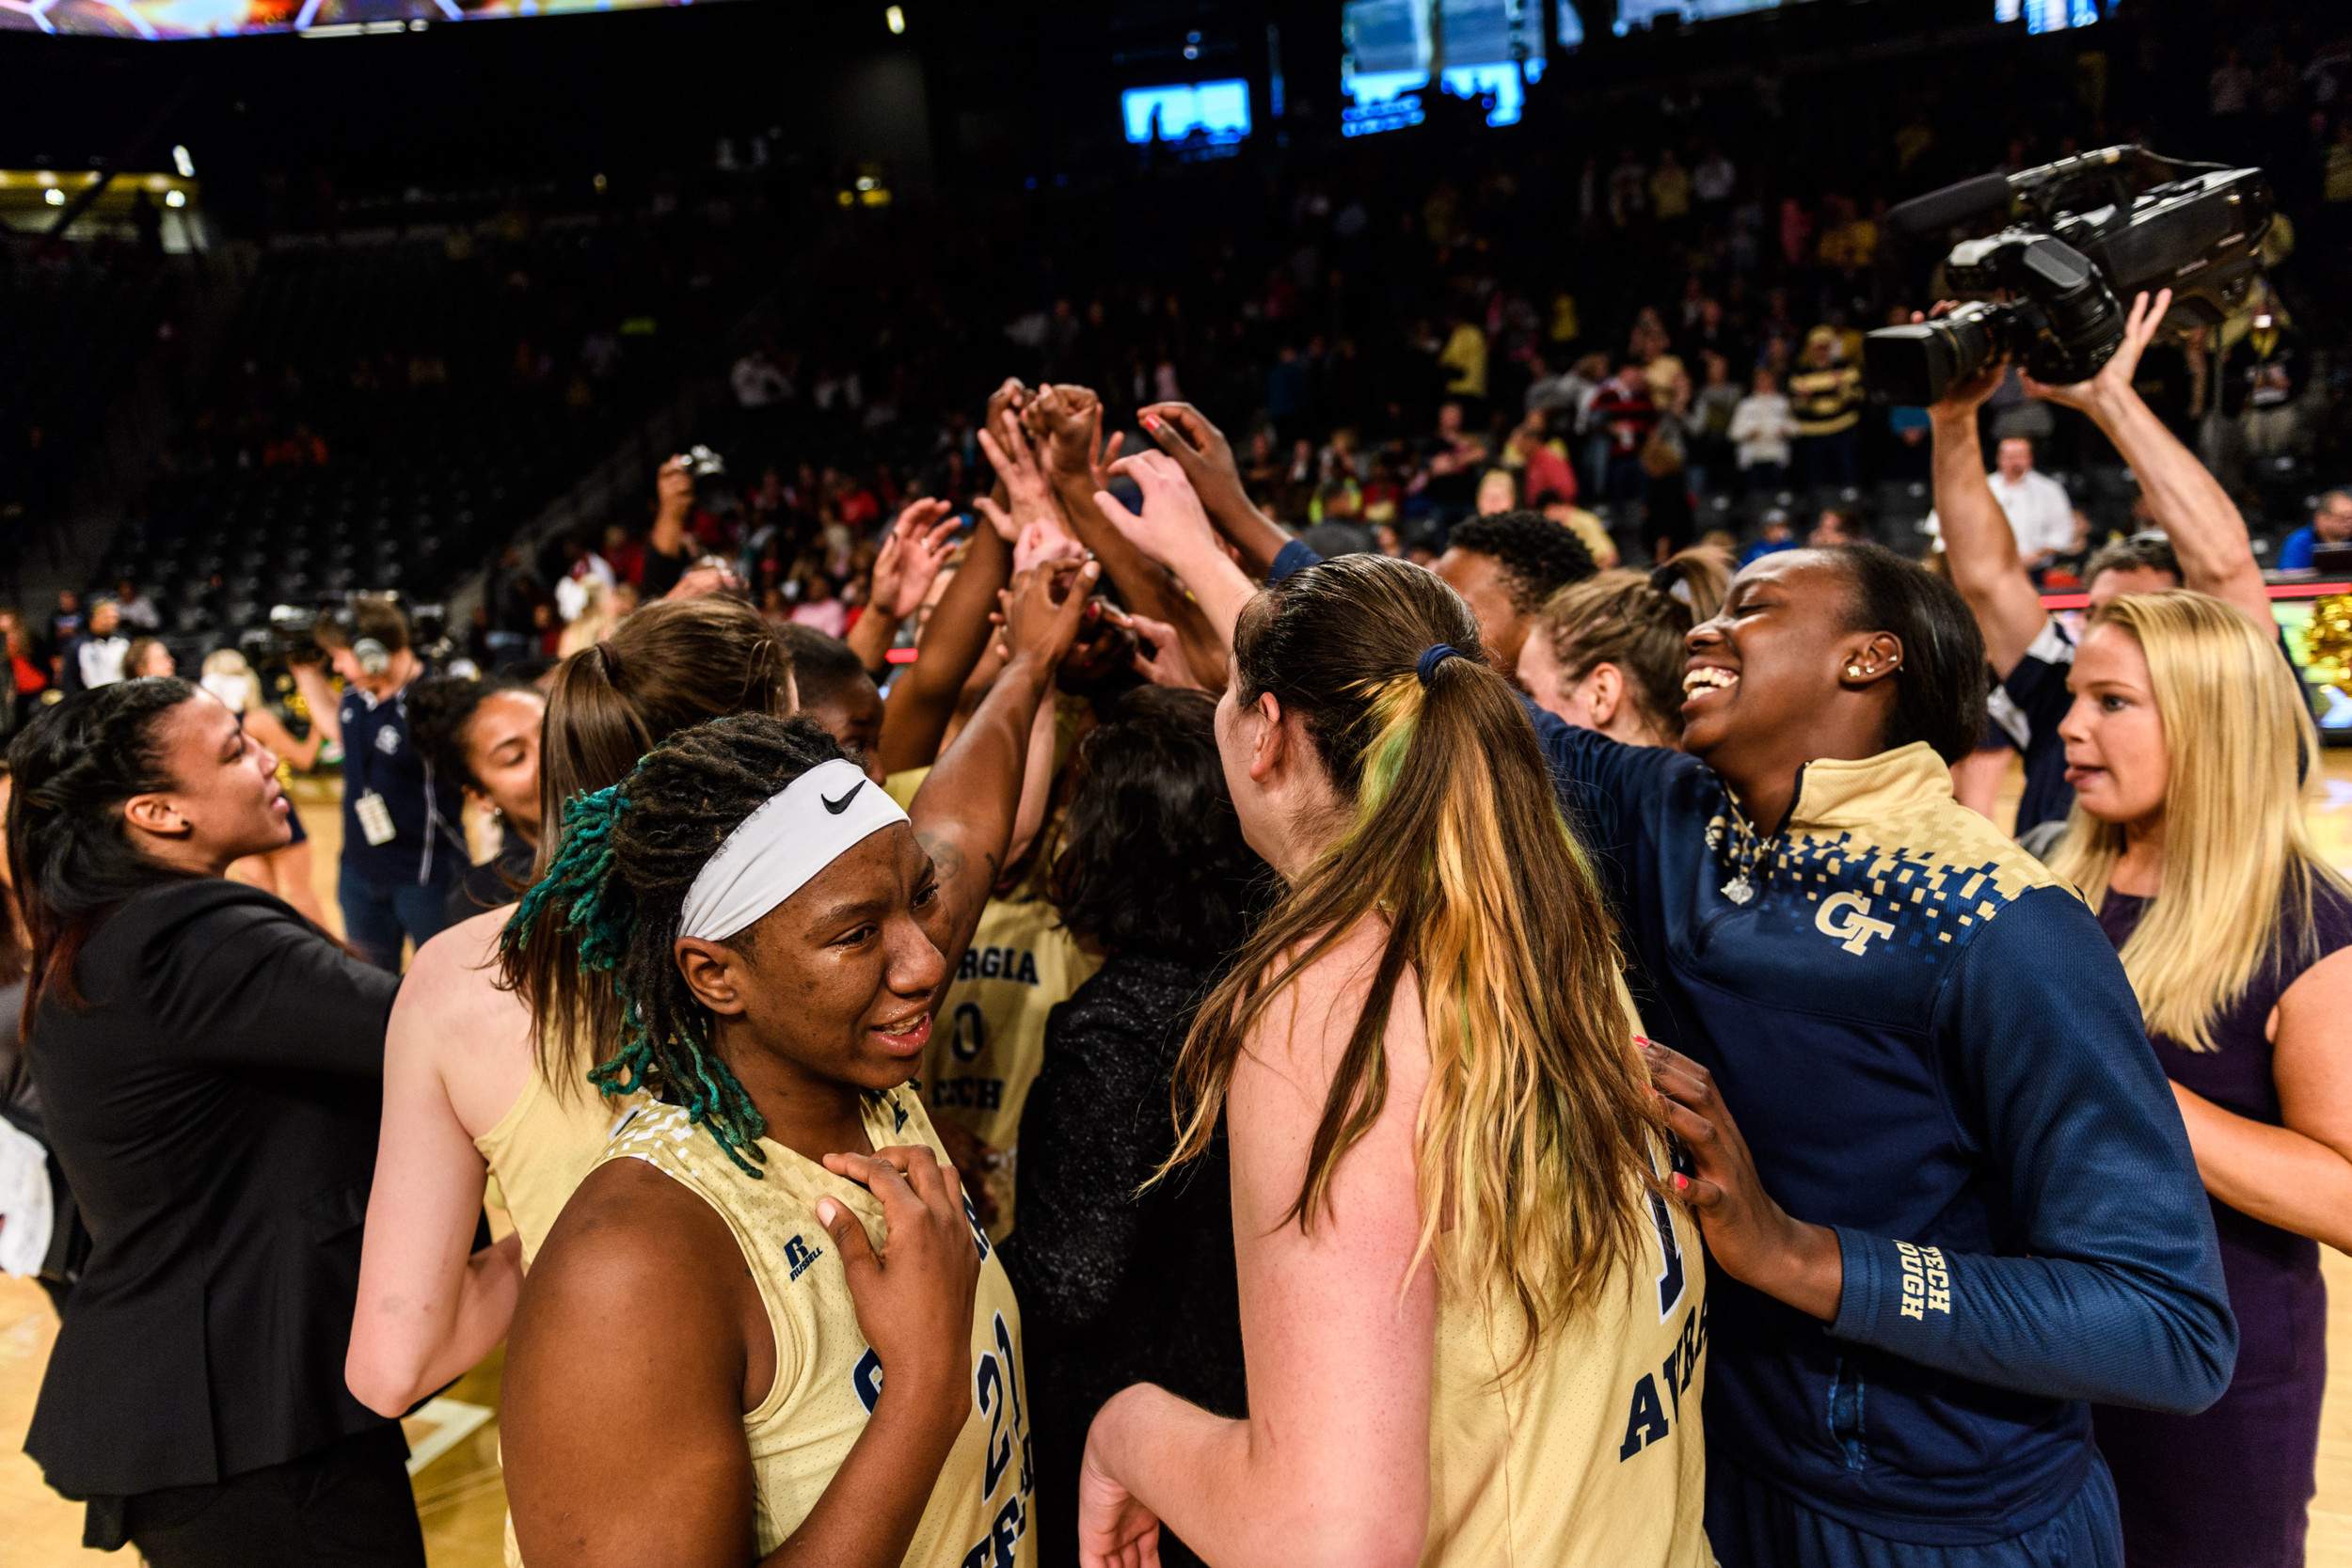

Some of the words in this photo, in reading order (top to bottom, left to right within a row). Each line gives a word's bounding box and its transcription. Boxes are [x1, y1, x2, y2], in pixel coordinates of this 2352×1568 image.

[1814, 891, 1896, 957] GT
[958, 946, 1040, 986] RGIA
[789, 1246, 823, 1283] RUSSELL
[1892, 1239, 1925, 1322] OUGH
[975, 1307, 1021, 1507] 21
